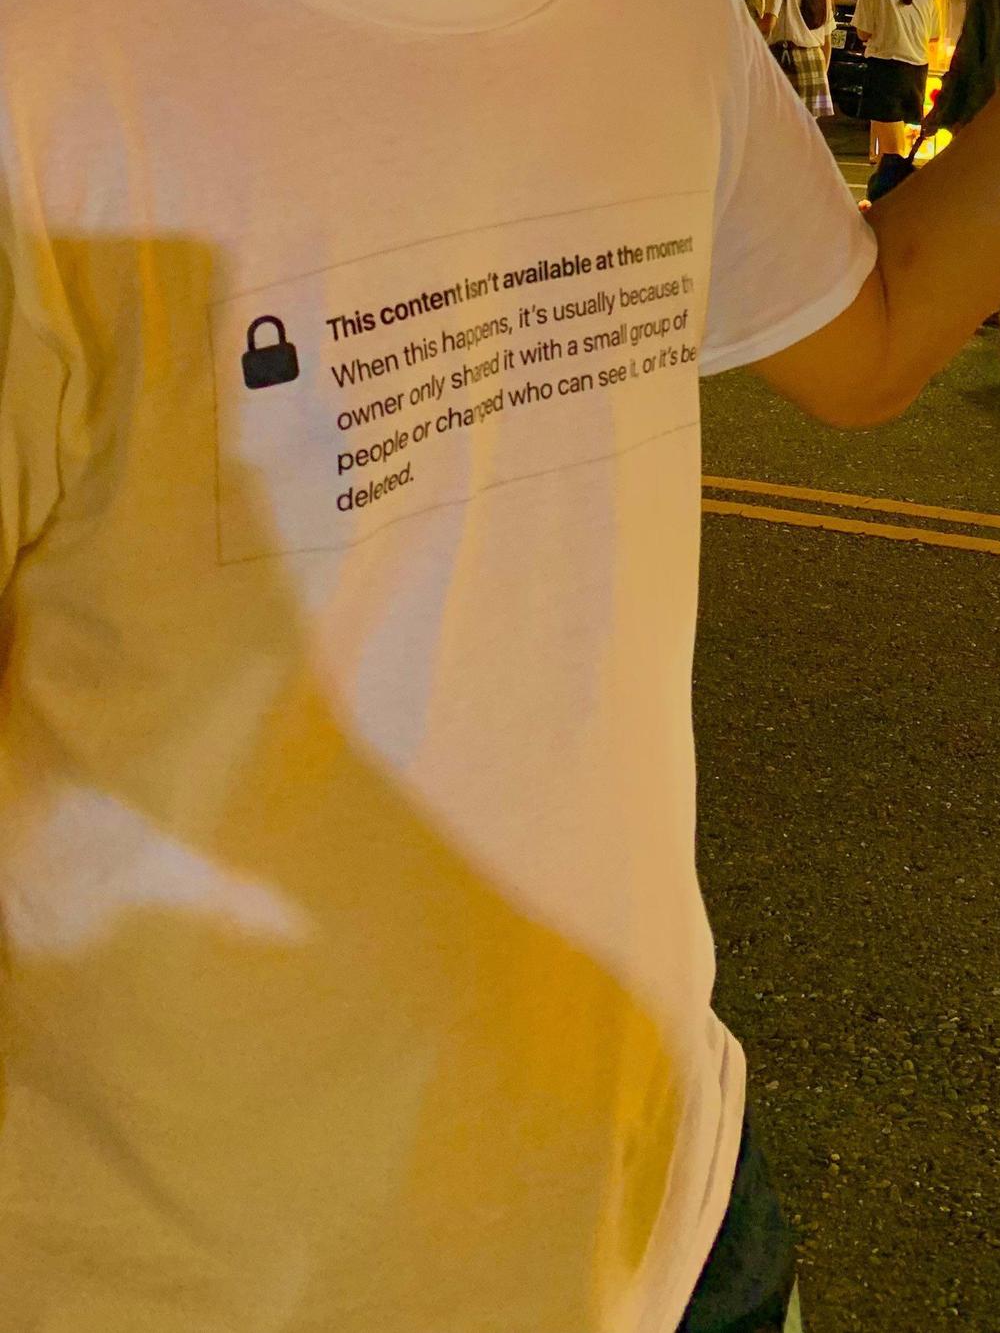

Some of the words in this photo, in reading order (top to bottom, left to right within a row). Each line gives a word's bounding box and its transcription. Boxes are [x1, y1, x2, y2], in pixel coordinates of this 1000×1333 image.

[326, 310, 376, 341] This
[380, 282, 463, 325] content
[465, 272, 500, 301] isn't
[503, 254, 591, 289] available
[596, 250, 614, 270] at
[617, 245, 643, 266] the
[331, 353, 399, 388] When
[403, 338, 438, 366] this
[442, 316, 513, 354] happens,
[519, 305, 547, 328] it's
[553, 292, 615, 321] usually
[620, 278, 679, 308] because
[337, 393, 405, 431] owner
[410, 375, 446, 406] only
[451, 351, 500, 390] shared
[503, 349, 515, 370] it
[520, 339, 562, 365] with
[567, 340, 578, 357] a
[583, 323, 628, 353] small
[631, 319, 671, 347] group
[673, 310, 689, 331] of
[337, 430, 409, 475] people
[412, 420, 432, 443] or
[508, 381, 552, 407] who
[558, 374, 594, 396] can
[598, 365, 627, 387] see
[642, 354, 657, 374] or
[659, 346, 678, 368] it's
[336, 461, 415, 512] deleted.
